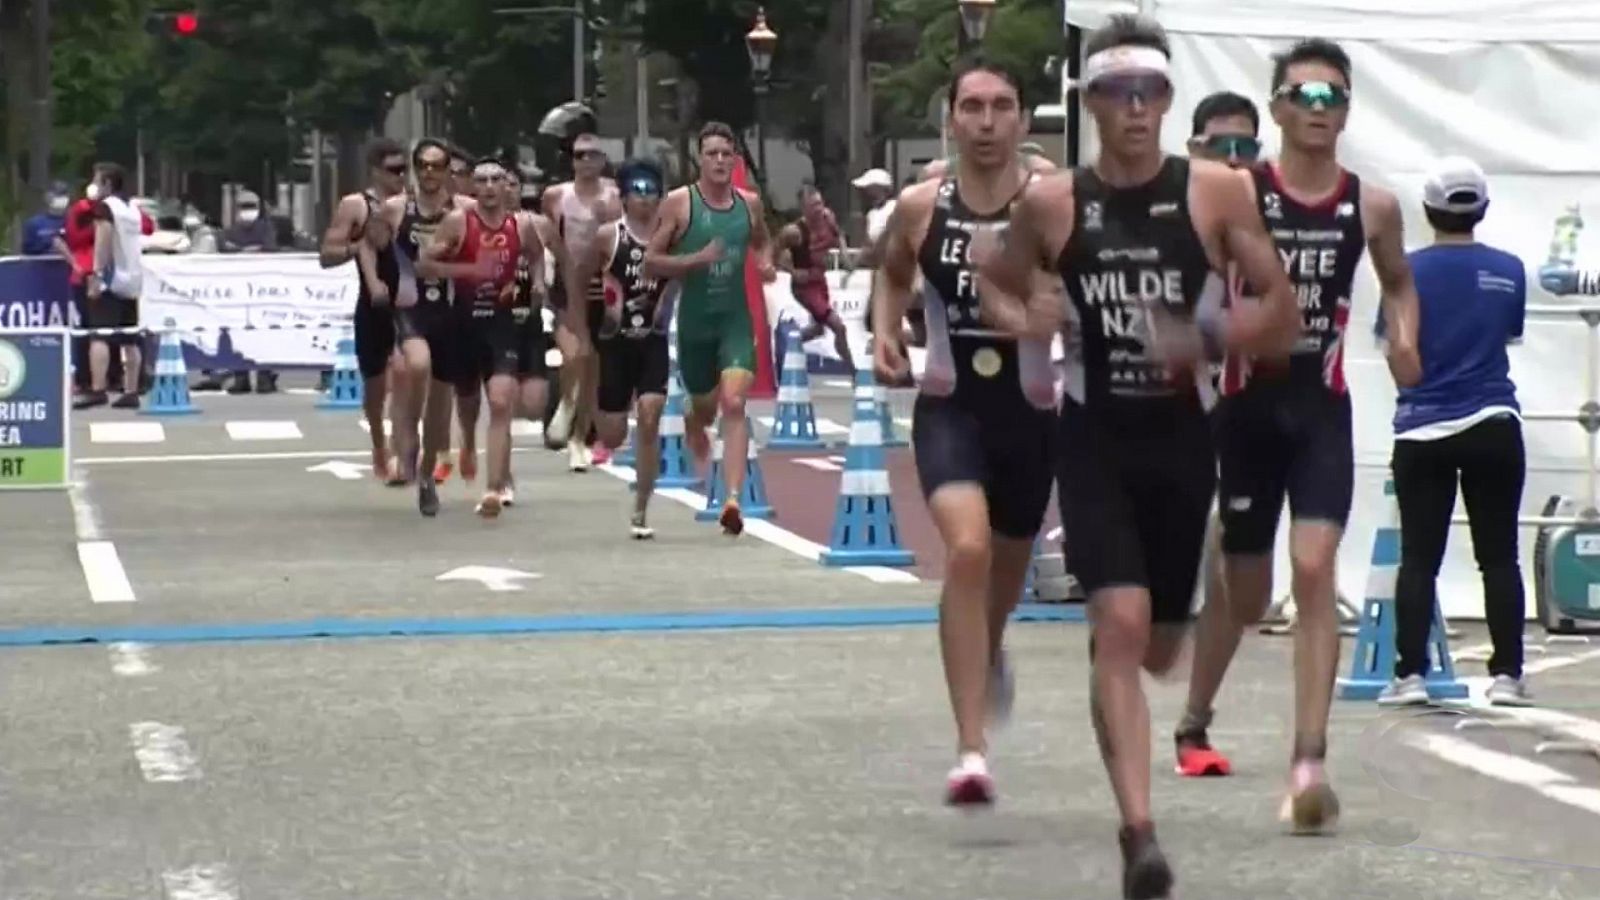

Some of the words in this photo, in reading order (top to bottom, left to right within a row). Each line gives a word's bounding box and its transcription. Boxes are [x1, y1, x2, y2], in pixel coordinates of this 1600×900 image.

[940, 238, 965, 264] LE
[1278, 247, 1337, 278] YEE
[1079, 270, 1185, 306] WILDE
